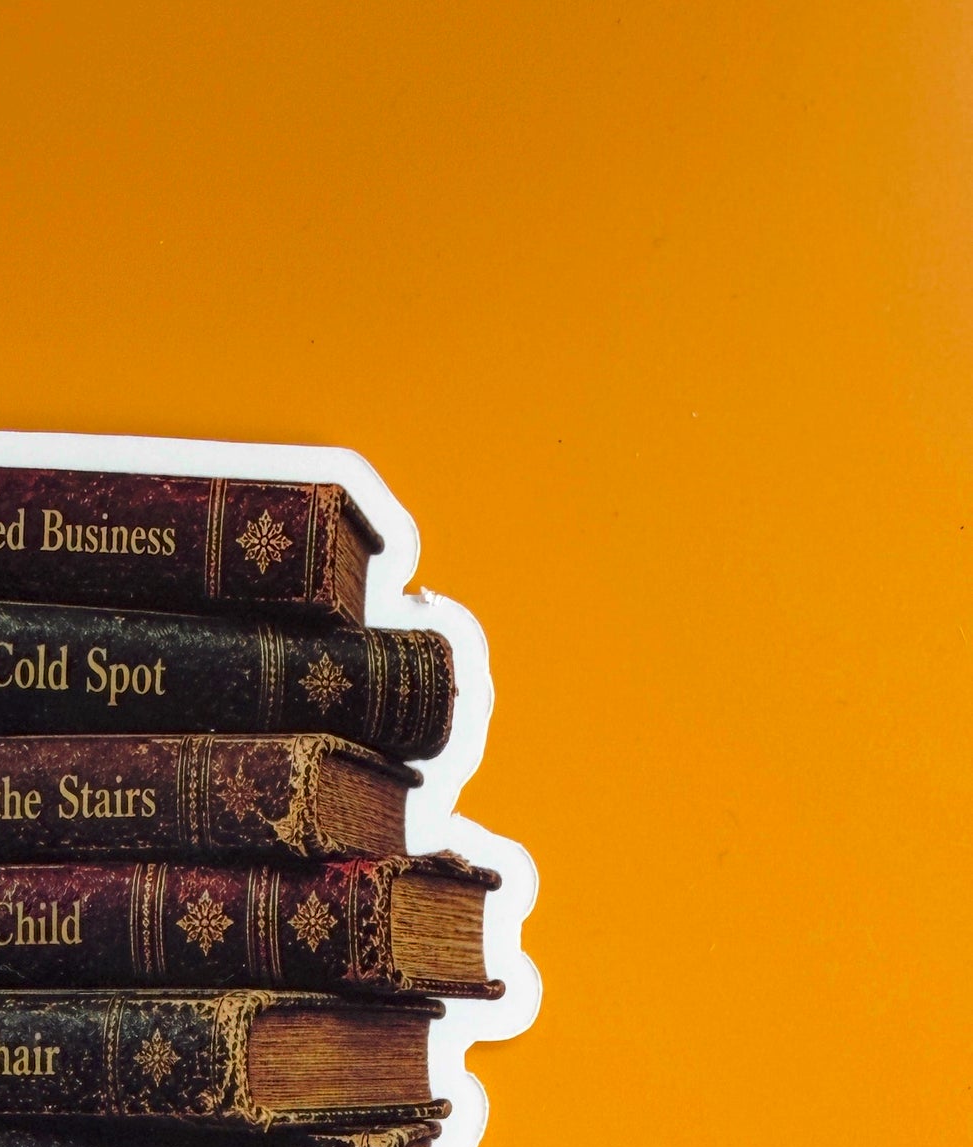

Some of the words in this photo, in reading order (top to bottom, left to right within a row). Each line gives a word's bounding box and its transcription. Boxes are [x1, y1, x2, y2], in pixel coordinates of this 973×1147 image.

[39, 509, 176, 556] Business
[86, 646, 167, 706] Spot
[58, 774, 156, 820] Stairs
